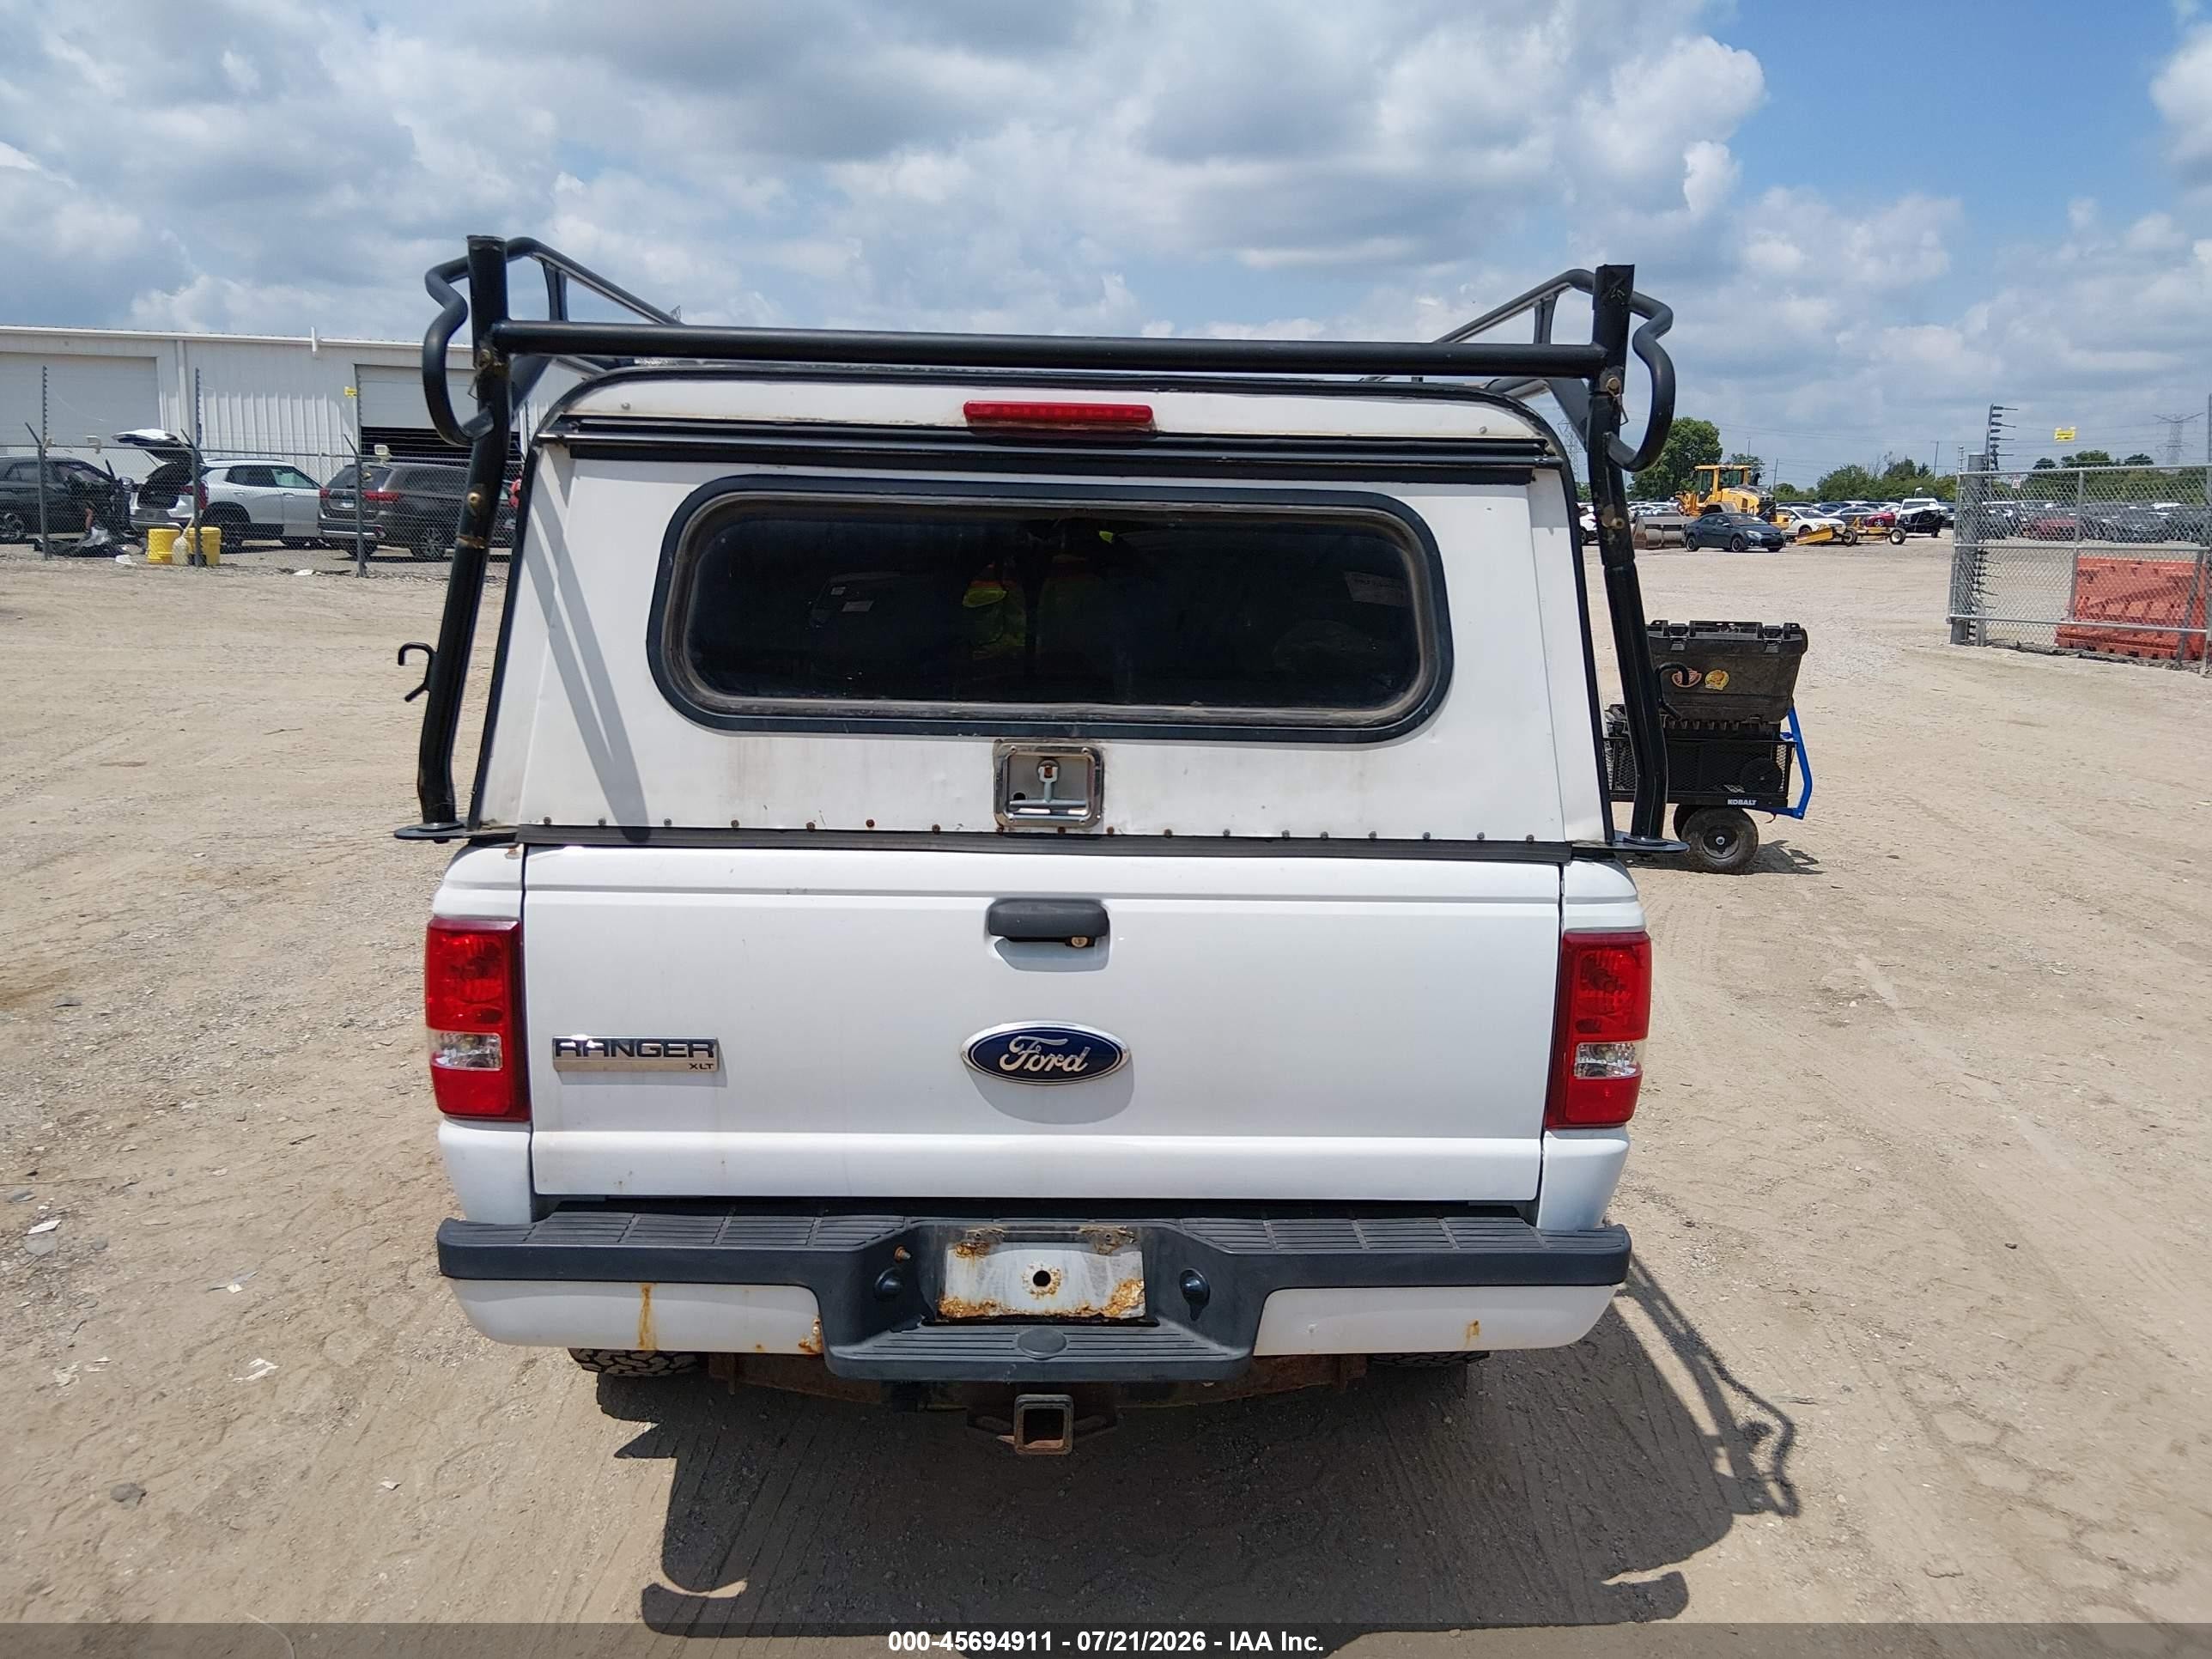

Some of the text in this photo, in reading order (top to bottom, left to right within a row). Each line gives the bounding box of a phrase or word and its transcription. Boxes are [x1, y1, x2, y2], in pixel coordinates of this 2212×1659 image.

[555, 1037, 715, 1058] RANGER
[999, 1036, 1091, 1073] Ford
[688, 1062, 714, 1071] XLT
